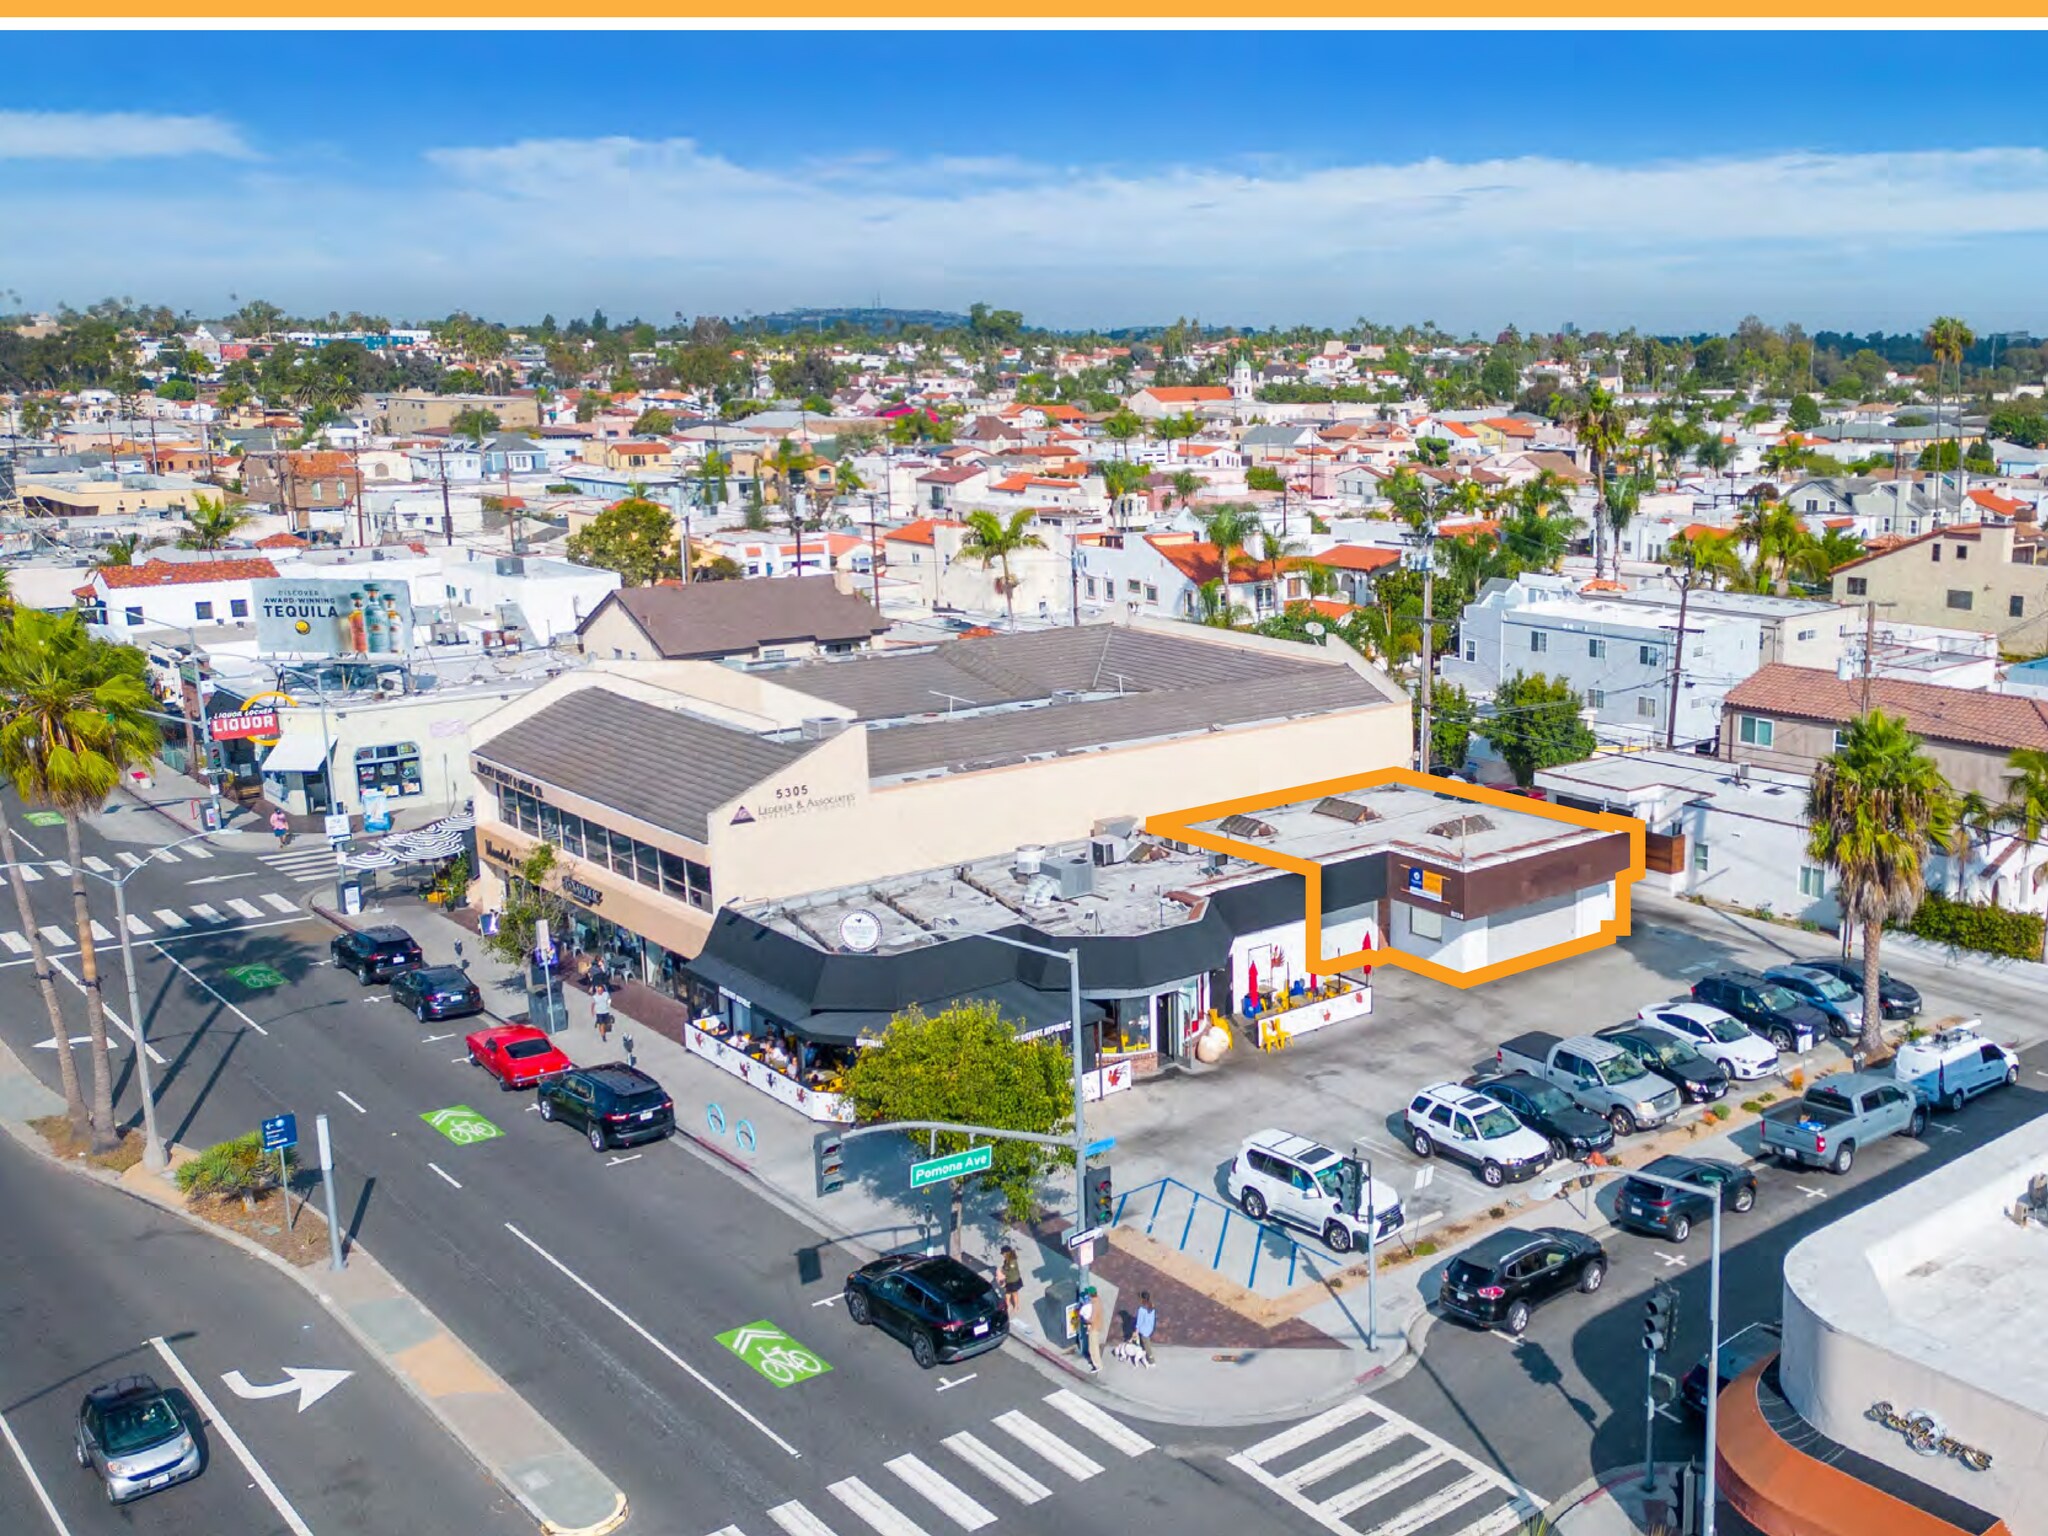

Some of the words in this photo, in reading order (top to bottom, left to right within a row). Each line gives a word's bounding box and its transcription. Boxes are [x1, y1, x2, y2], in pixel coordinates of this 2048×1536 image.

[263, 605, 339, 618] TEQUILA
[213, 711, 243, 720] LIQUOR
[244, 708, 273, 717] LOCKER
[213, 715, 274, 732] LIQUOR
[776, 784, 808, 799] 5305
[915, 1163, 963, 1181] Pomona
[965, 1155, 987, 1168] Ave
